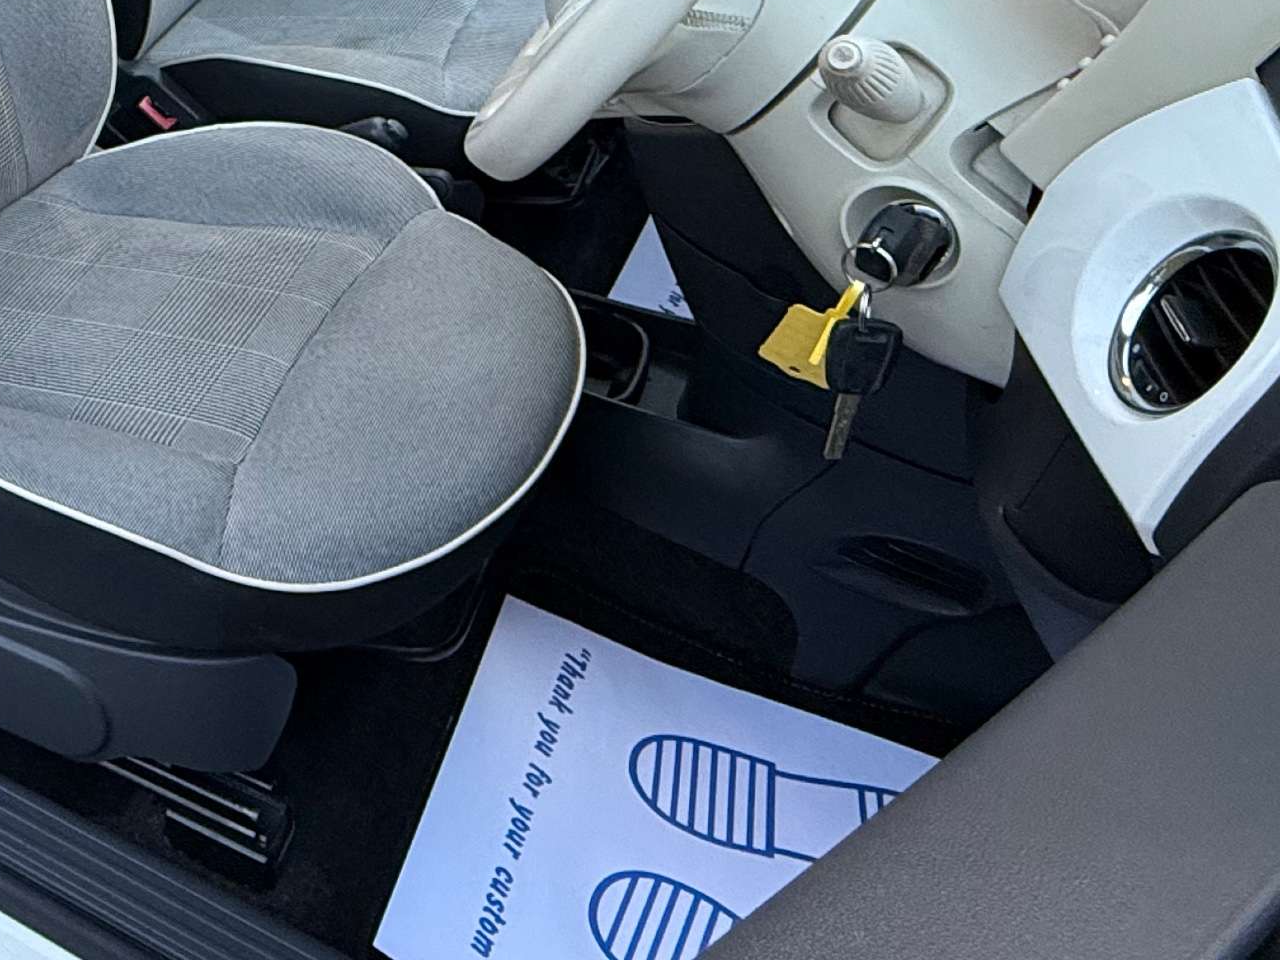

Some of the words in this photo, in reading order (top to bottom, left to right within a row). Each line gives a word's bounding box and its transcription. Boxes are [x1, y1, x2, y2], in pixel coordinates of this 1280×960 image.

[536, 711, 561, 758] you
[522, 762, 553, 800] for
[502, 796, 535, 861] your
[469, 865, 514, 959] custom
